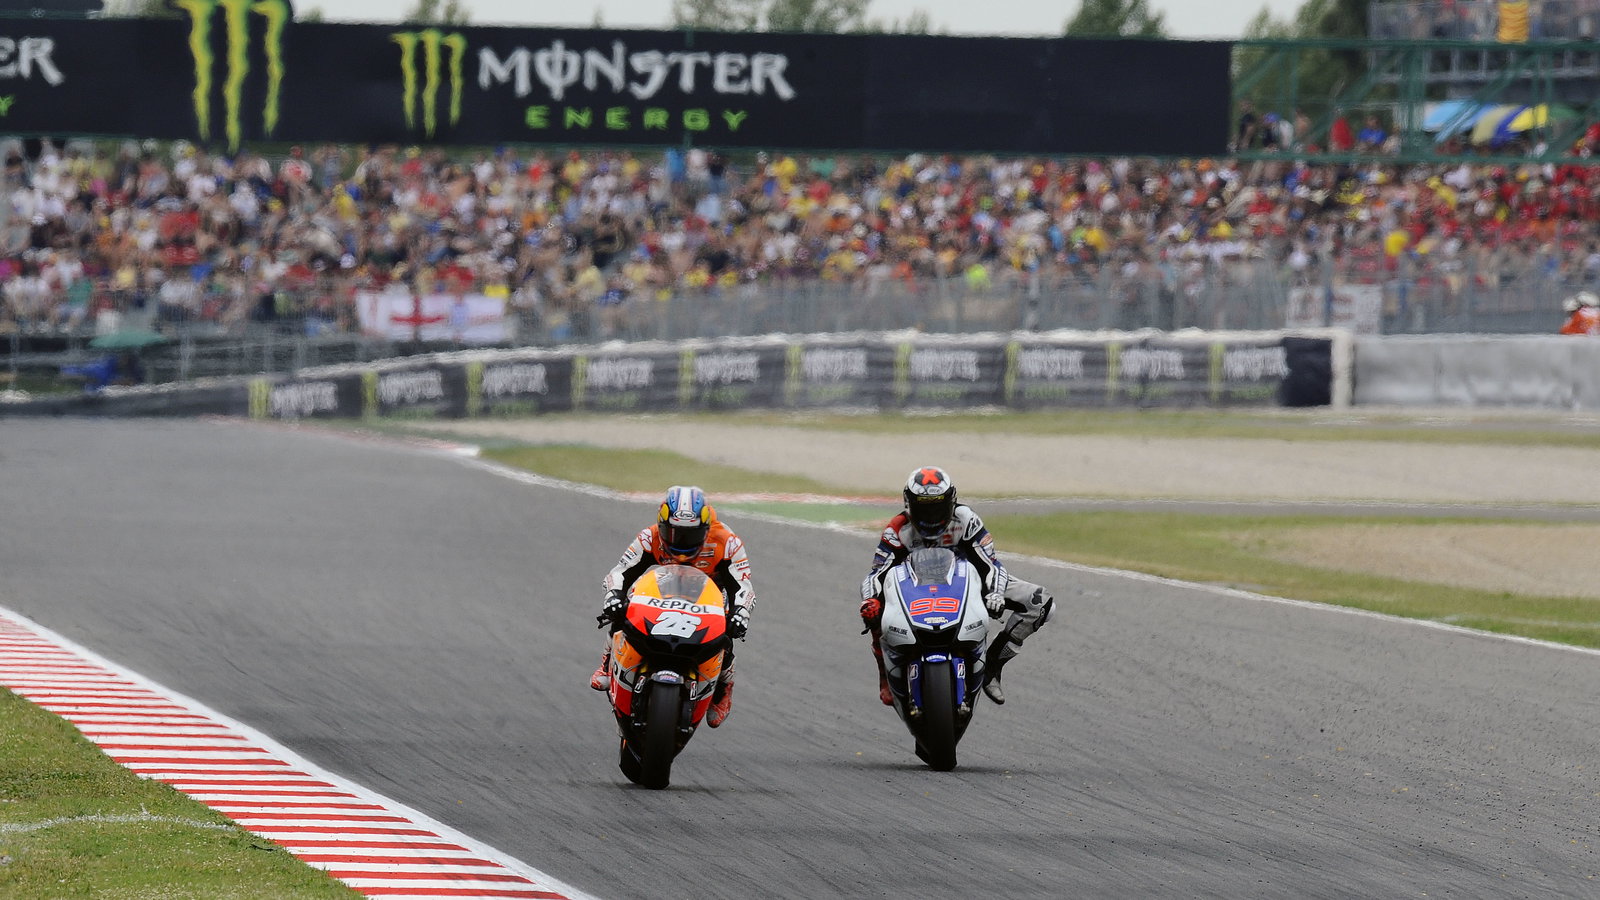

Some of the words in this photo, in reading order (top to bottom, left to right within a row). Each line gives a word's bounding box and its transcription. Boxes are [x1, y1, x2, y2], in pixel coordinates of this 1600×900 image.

[477, 40, 796, 101] MONSTER
[524, 105, 749, 131] ENERGY
[648, 598, 710, 613] REPSOL
[909, 597, 960, 616] 99
[650, 611, 702, 639] 26
